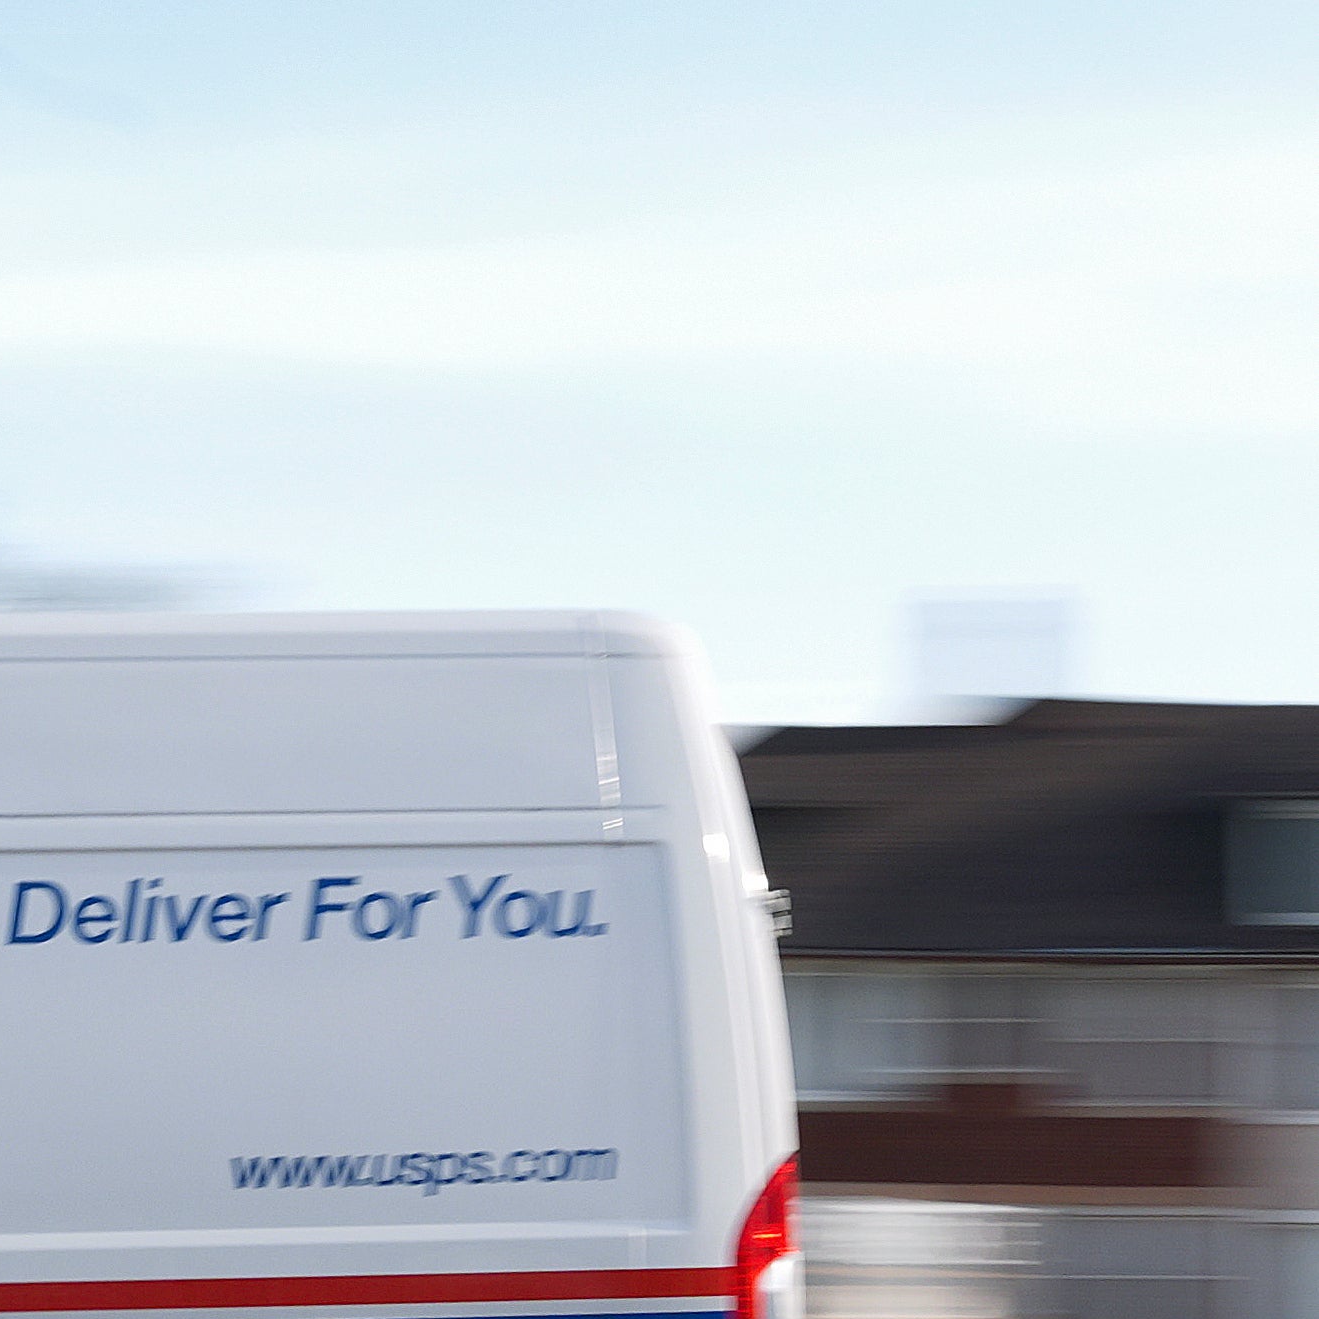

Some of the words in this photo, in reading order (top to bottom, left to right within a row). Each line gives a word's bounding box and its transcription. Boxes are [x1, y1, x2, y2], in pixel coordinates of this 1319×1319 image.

[6, 878, 290, 945] Deliver
[304, 875, 440, 940] For
[450, 873, 609, 938] You.
[230, 1147, 616, 1196] www.usps.com
